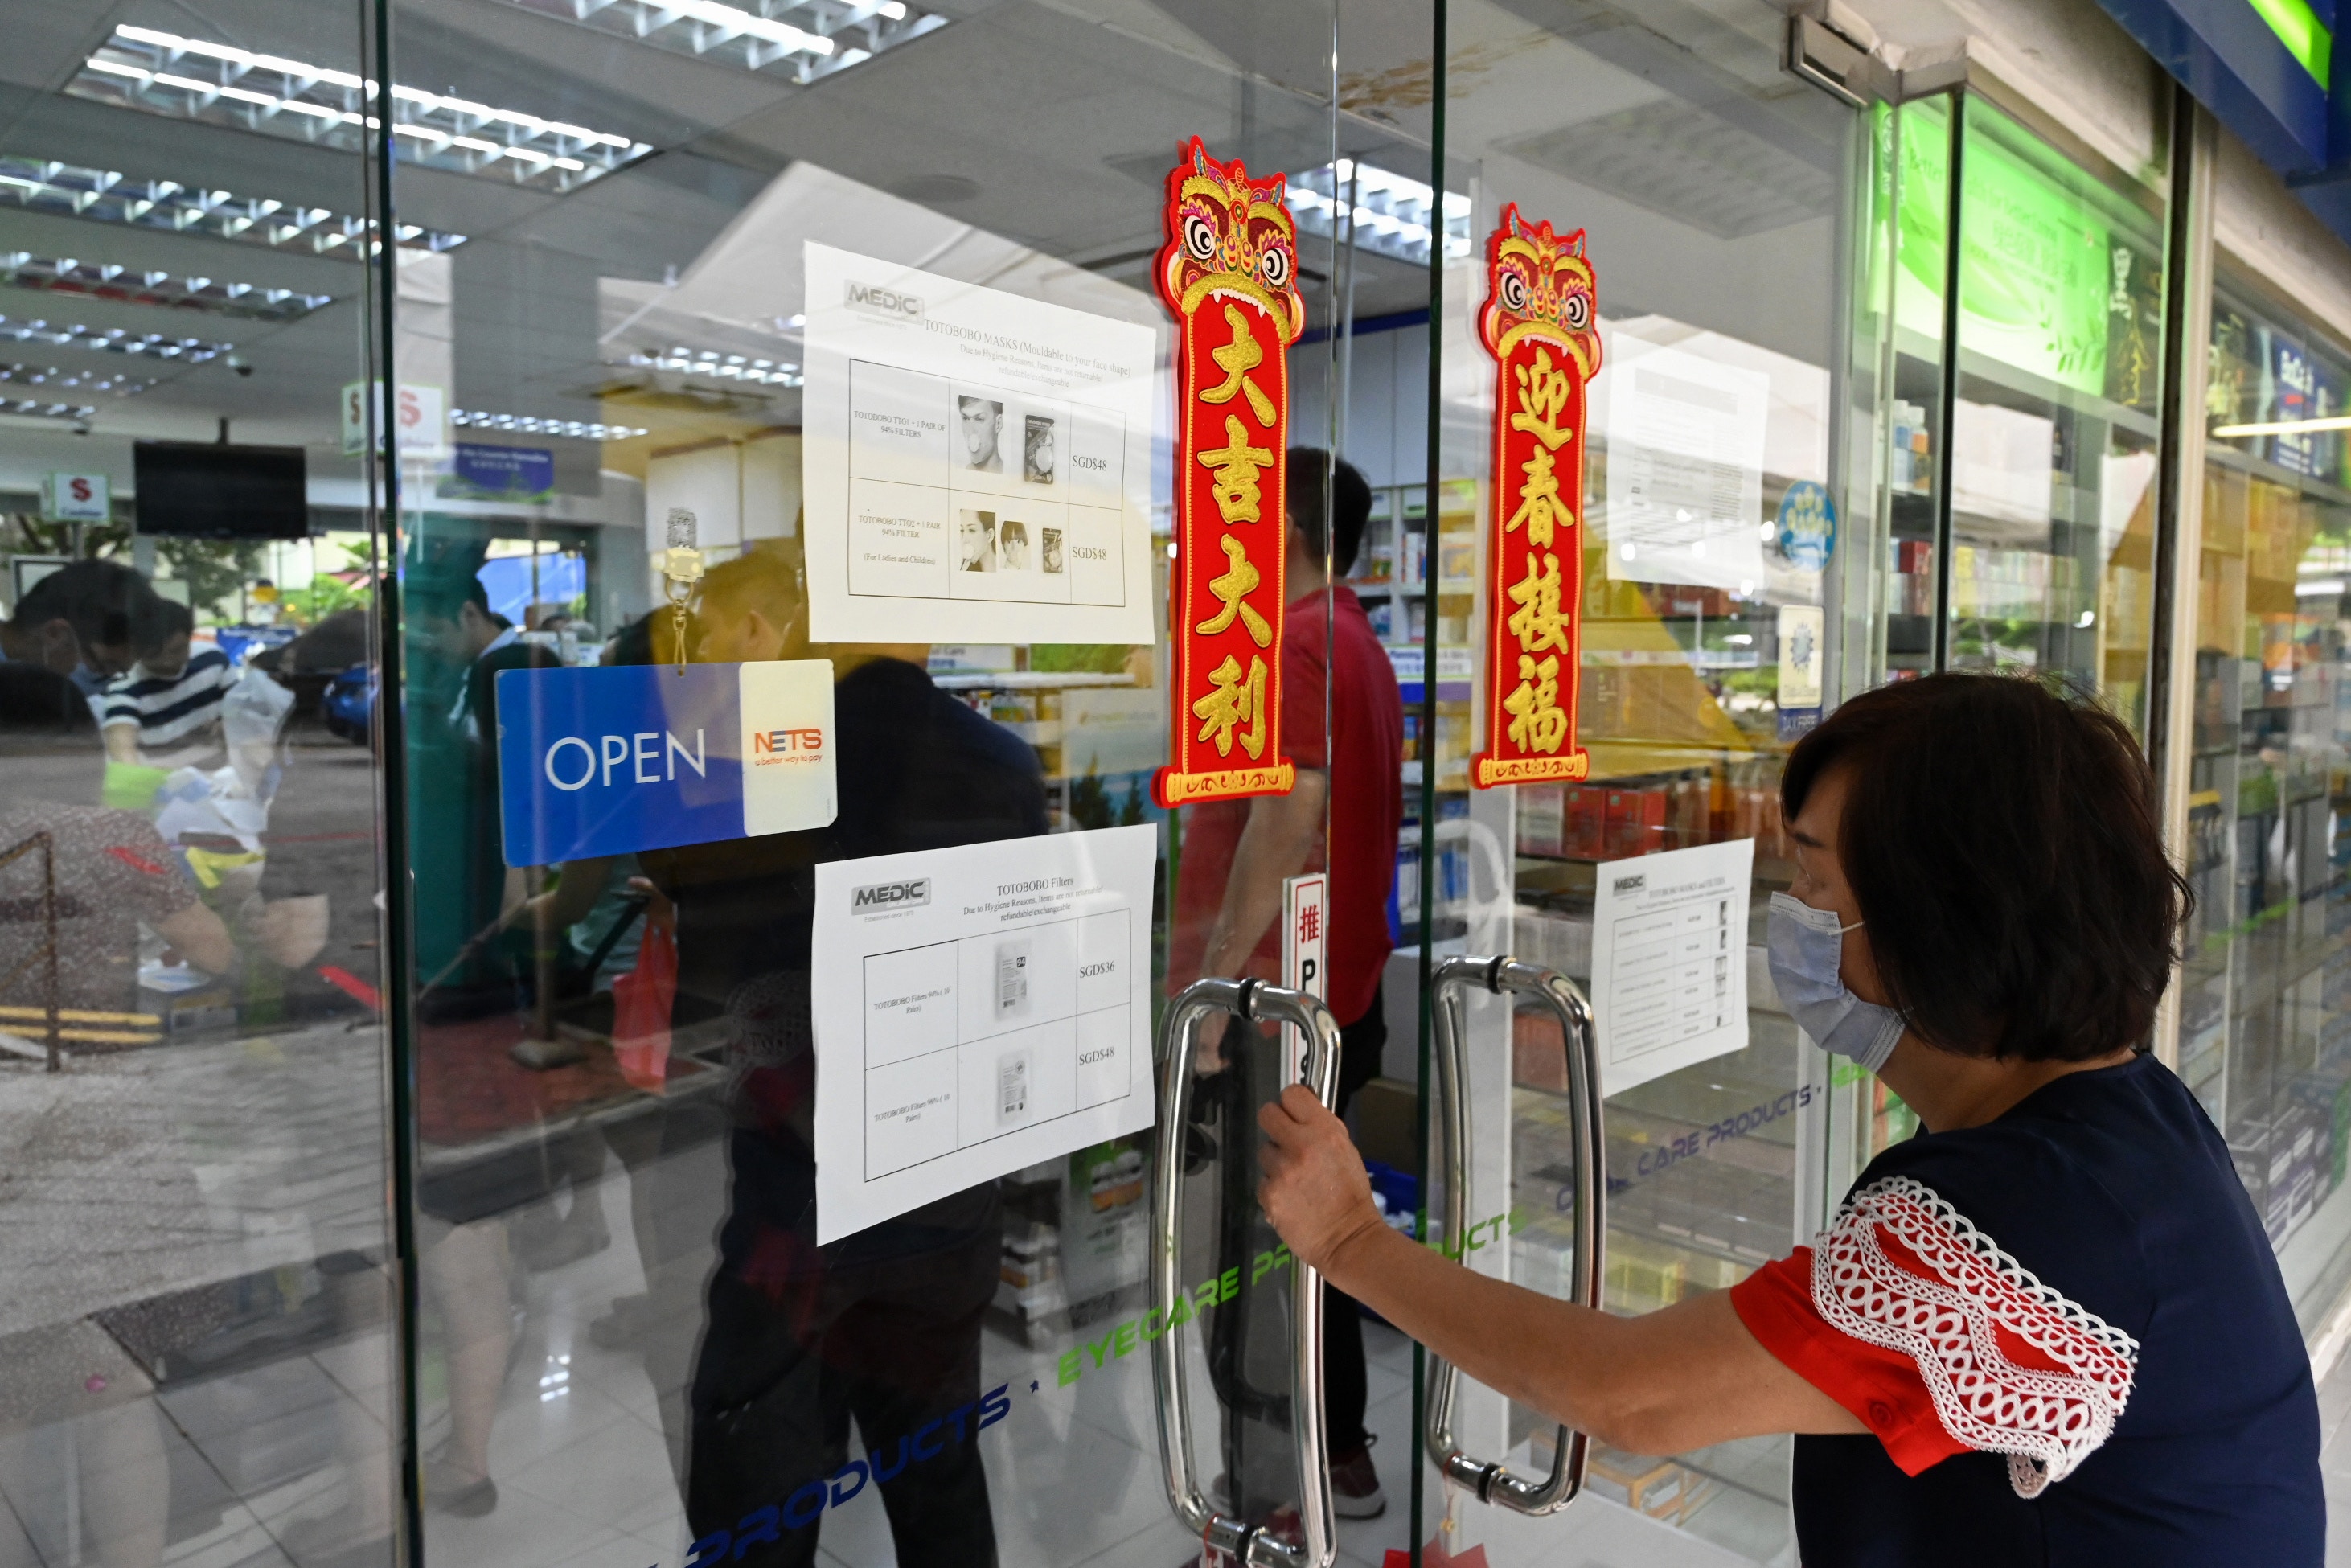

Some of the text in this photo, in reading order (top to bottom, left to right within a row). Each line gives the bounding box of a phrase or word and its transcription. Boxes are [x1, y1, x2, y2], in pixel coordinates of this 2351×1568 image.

[924, 318, 982, 342] TOTOBOBO
[984, 332, 1018, 350] MASKS
[1020, 341, 1063, 361] (Mouldable
[1065, 354, 1073, 363] to
[1075, 356, 1091, 367] your
[1093, 358, 1107, 370] face
[1109, 363, 1131, 377] shape)
[959, 343, 973, 354] Due
[974, 348, 982, 356] to
[983, 349, 1008, 361] Hygiene
[1053, 365, 1063, 374] are
[1064, 367, 1073, 376] not
[854, 410, 892, 423] TOTOBOBO
[921, 421, 936, 430] PAIR
[938, 423, 946, 432] OF
[880, 425, 921, 438] 94% FILTERS
[1073, 455, 1107, 471] SGD$48
[859, 515, 896, 525] TOTOBOBO
[896, 530, 920, 538] FILTER
[1193, 303, 1277, 760] 大吉大利
[864, 552, 876, 560] (For
[878, 554, 896, 562] Ladies
[909, 556, 936, 565] Children)
[1073, 546, 1107, 560] SGD$48
[1502, 346, 1575, 755] 迎春接福
[754, 729, 822, 753] NETS
[545, 729, 706, 791] OPEN
[761, 757, 782, 766] better
[785, 757, 799, 765] way
[808, 755, 823, 763] pay
[997, 876, 1074, 897] TOTOBOBO Filters
[963, 906, 975, 915] Due
[984, 901, 1010, 913] Hygiene
[1011, 897, 1037, 907] Reasons,
[1039, 894, 1054, 903] Items
[1000, 902, 1071, 922] refundable/exchangeable
[1299, 903, 1319, 944] 推
[1080, 961, 1115, 978] SGD$36
[874, 996, 910, 1010] TOTOBOBO
[911, 994, 927, 1003] Filters
[906, 1004, 921, 1013] Pairs)
[1079, 1047, 1114, 1066] SGD$48
[874, 1106, 910, 1122] TOTOBOBO
[910, 1102, 926, 1111] Filters
[906, 1113, 921, 1123] Pairs)
[1638, 1084, 1812, 1176] CARE PRODUCTS
[1058, 1266, 1240, 1389] EYECARE
